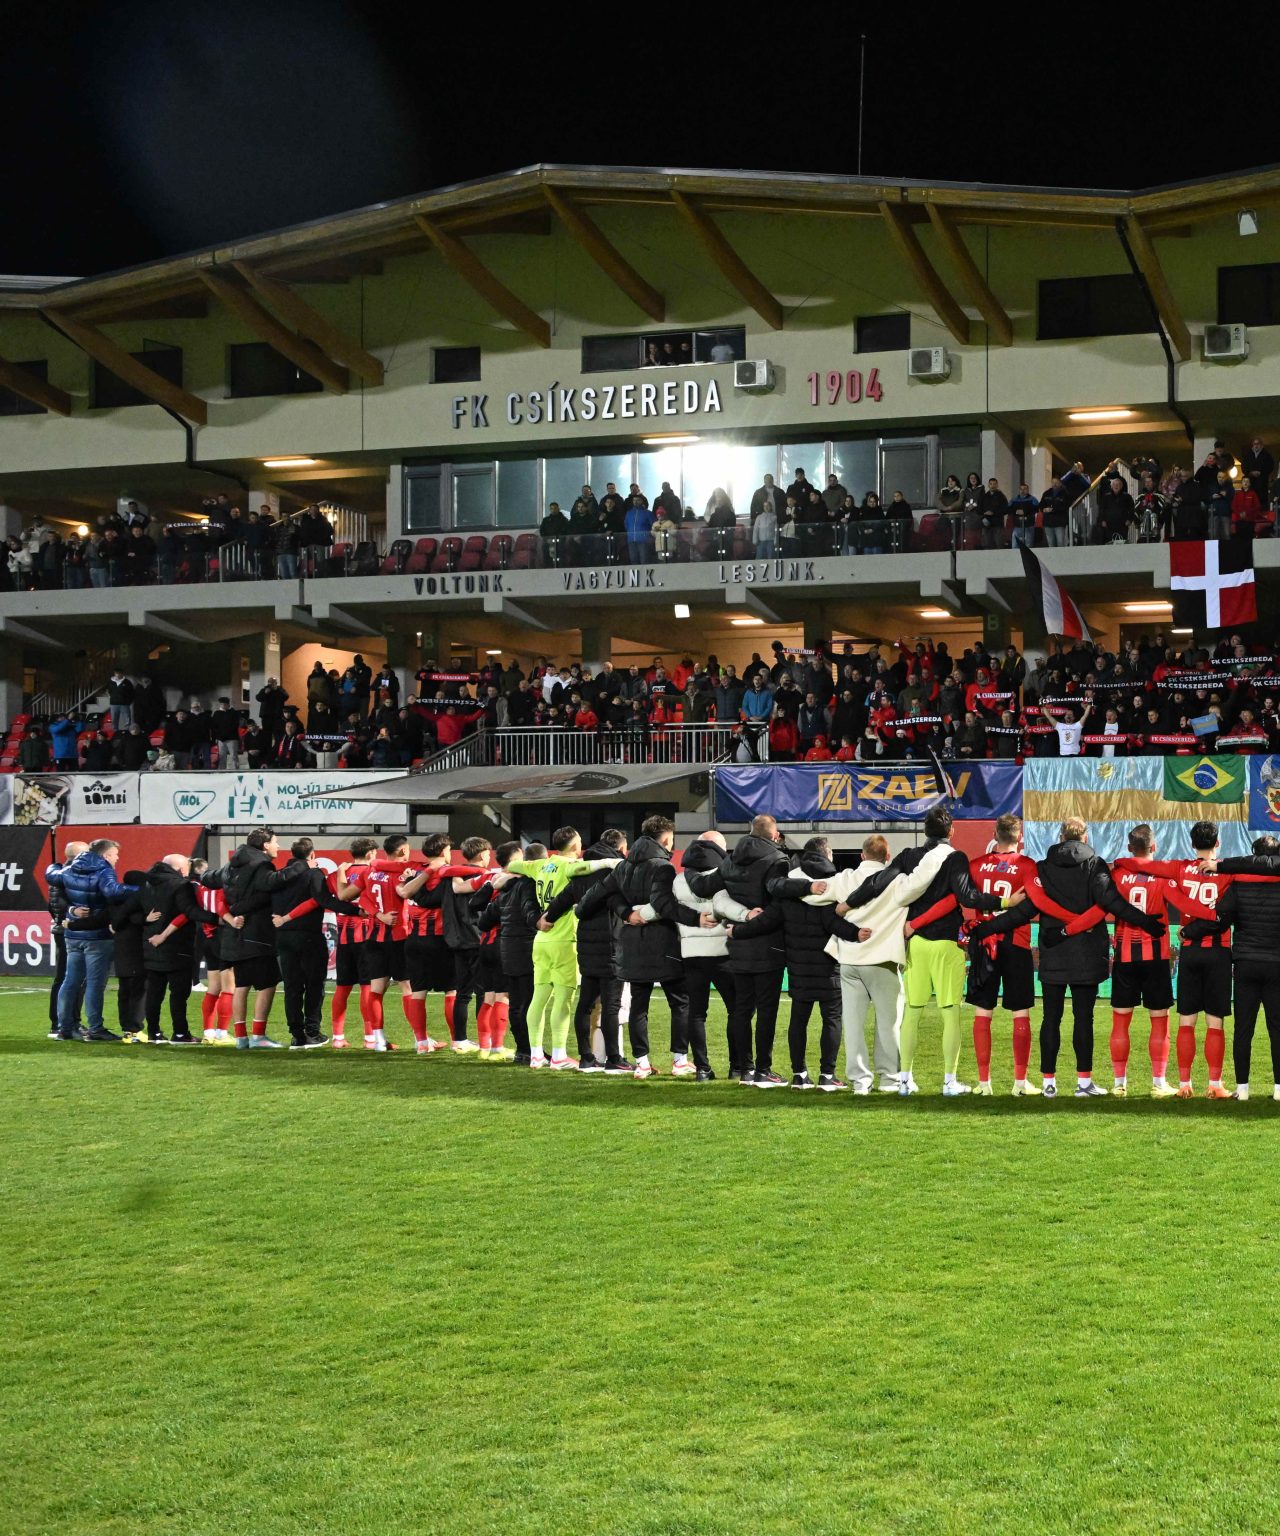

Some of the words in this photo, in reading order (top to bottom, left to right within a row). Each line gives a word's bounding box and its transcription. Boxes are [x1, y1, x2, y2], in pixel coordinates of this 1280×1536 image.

[807, 368, 883, 406] 1904
[452, 394, 488, 428] FK
[506, 379, 721, 425] CSÍKSZEREDA
[561, 568, 664, 591] VAGYUNK.
[719, 561, 825, 584] LESZÜNK.
[413, 574, 512, 596] VOLTUNK.
[179, 795, 200, 806] MOL
[979, 861, 1018, 875] MrBit
[371, 884, 383, 914] 3
